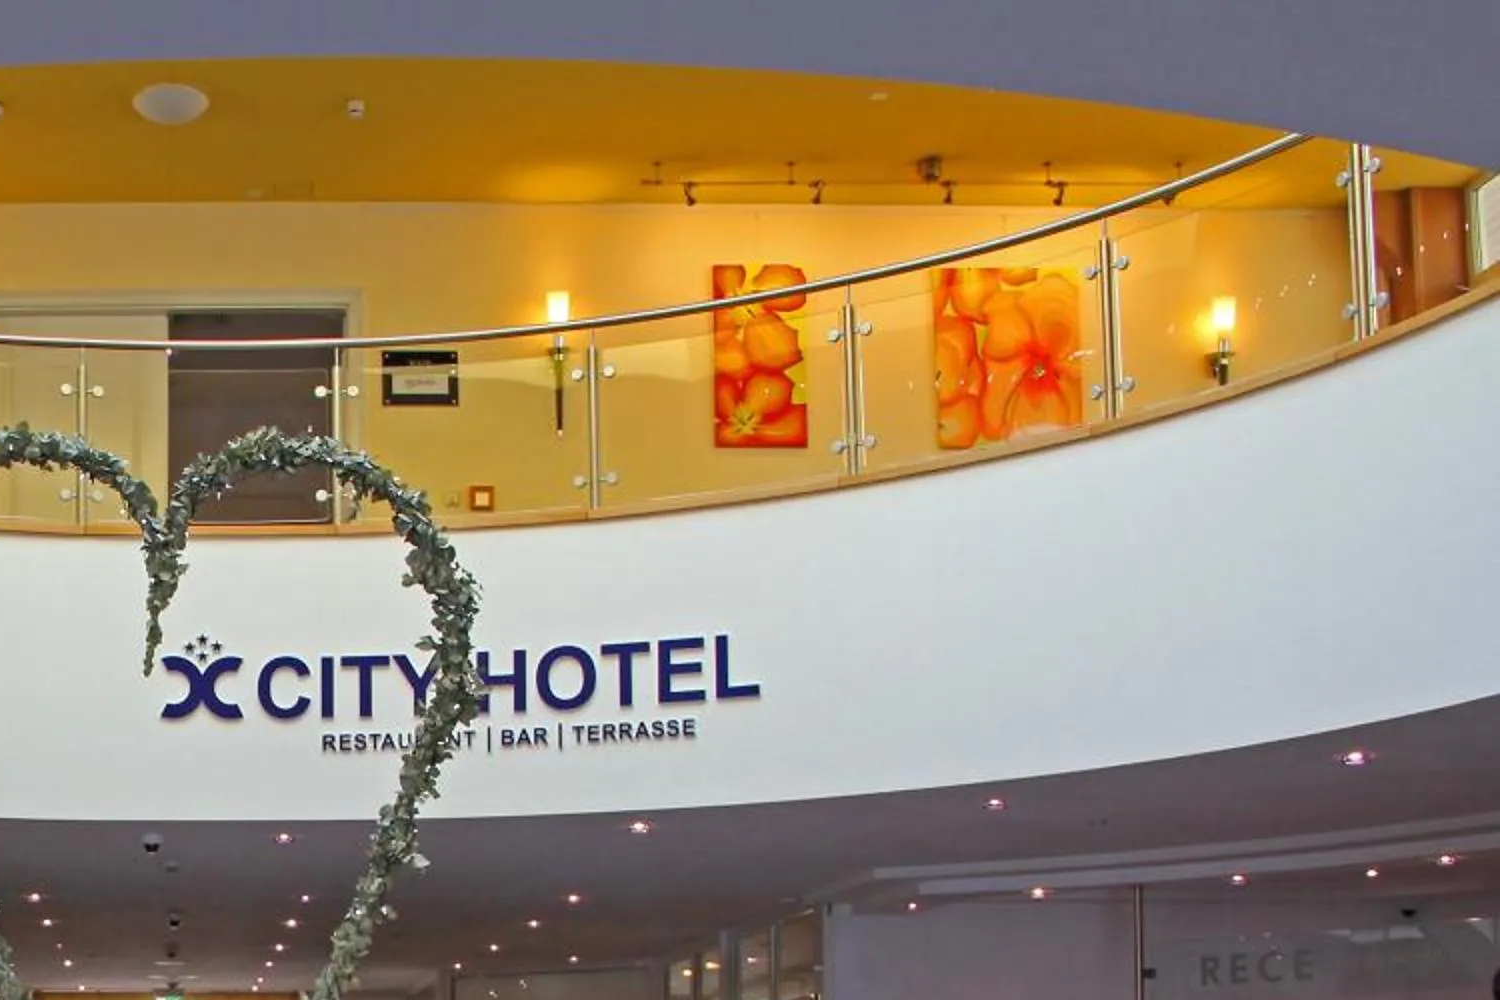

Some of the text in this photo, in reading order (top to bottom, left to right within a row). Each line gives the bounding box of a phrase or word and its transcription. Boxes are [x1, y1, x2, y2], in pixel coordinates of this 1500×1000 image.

[256, 634, 761, 721] CITY HOTEL
[321, 717, 697, 754] RESTAUNT BAR TERRASSE
